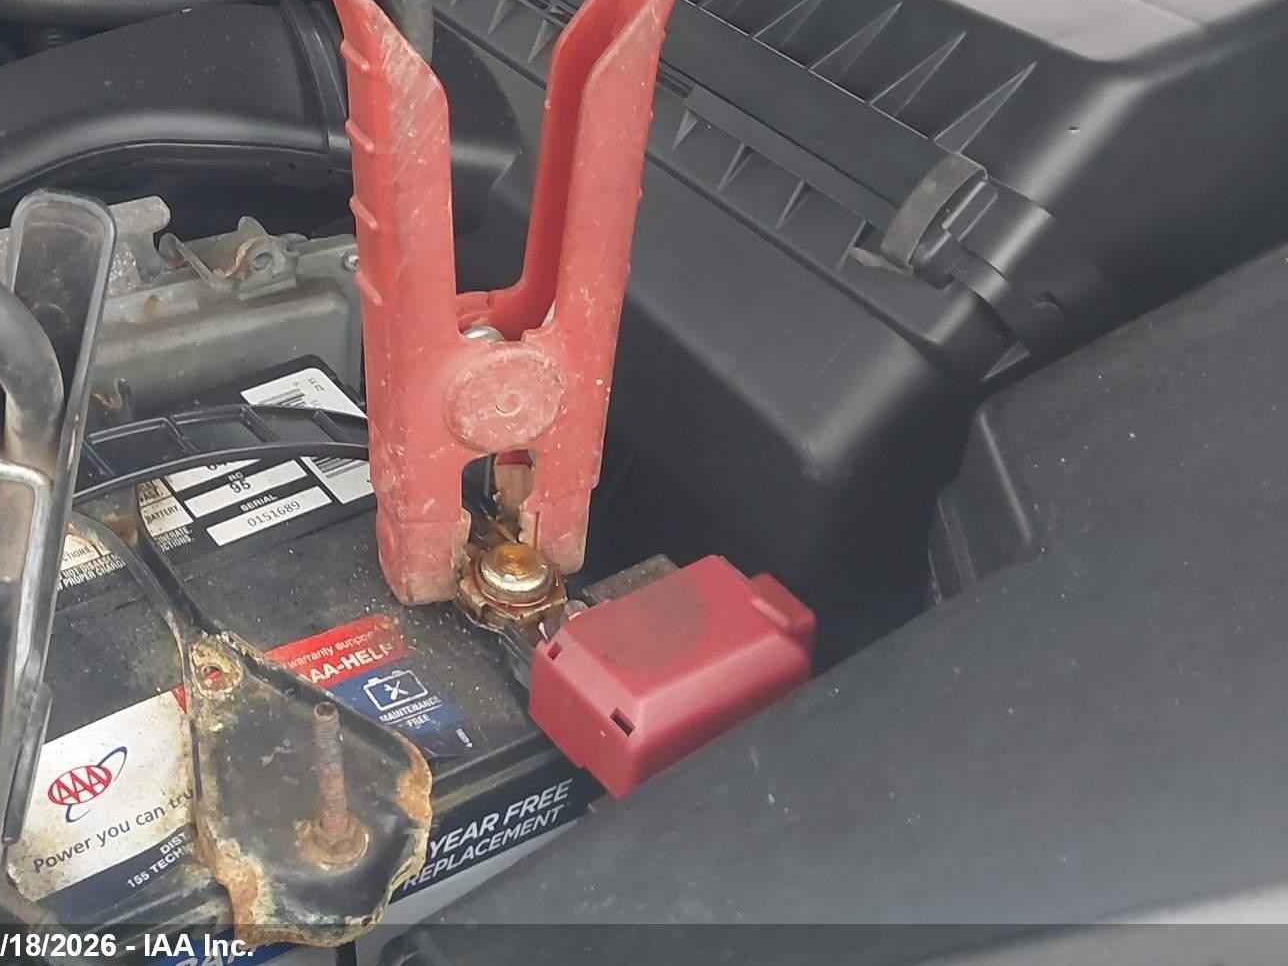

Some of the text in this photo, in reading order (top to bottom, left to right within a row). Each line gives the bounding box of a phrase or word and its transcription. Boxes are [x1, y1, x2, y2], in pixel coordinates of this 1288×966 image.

[229, 478, 251, 494] 95
[239, 493, 278, 512] SERIAL
[246, 499, 301, 528] 0151689
[286, 644, 335, 669] warranty
[378, 694, 443, 723] MAINTENANCE
[405, 713, 431, 728] FREE
[50, 765, 112, 805] AAA
[429, 778, 574, 859] YEAR FREE
[33, 837, 91, 874] Power
[96, 819, 131, 847] you
[135, 806, 165, 826] can
[403, 804, 565, 891] REPLACEMENT
[127, 870, 150, 889] 155
